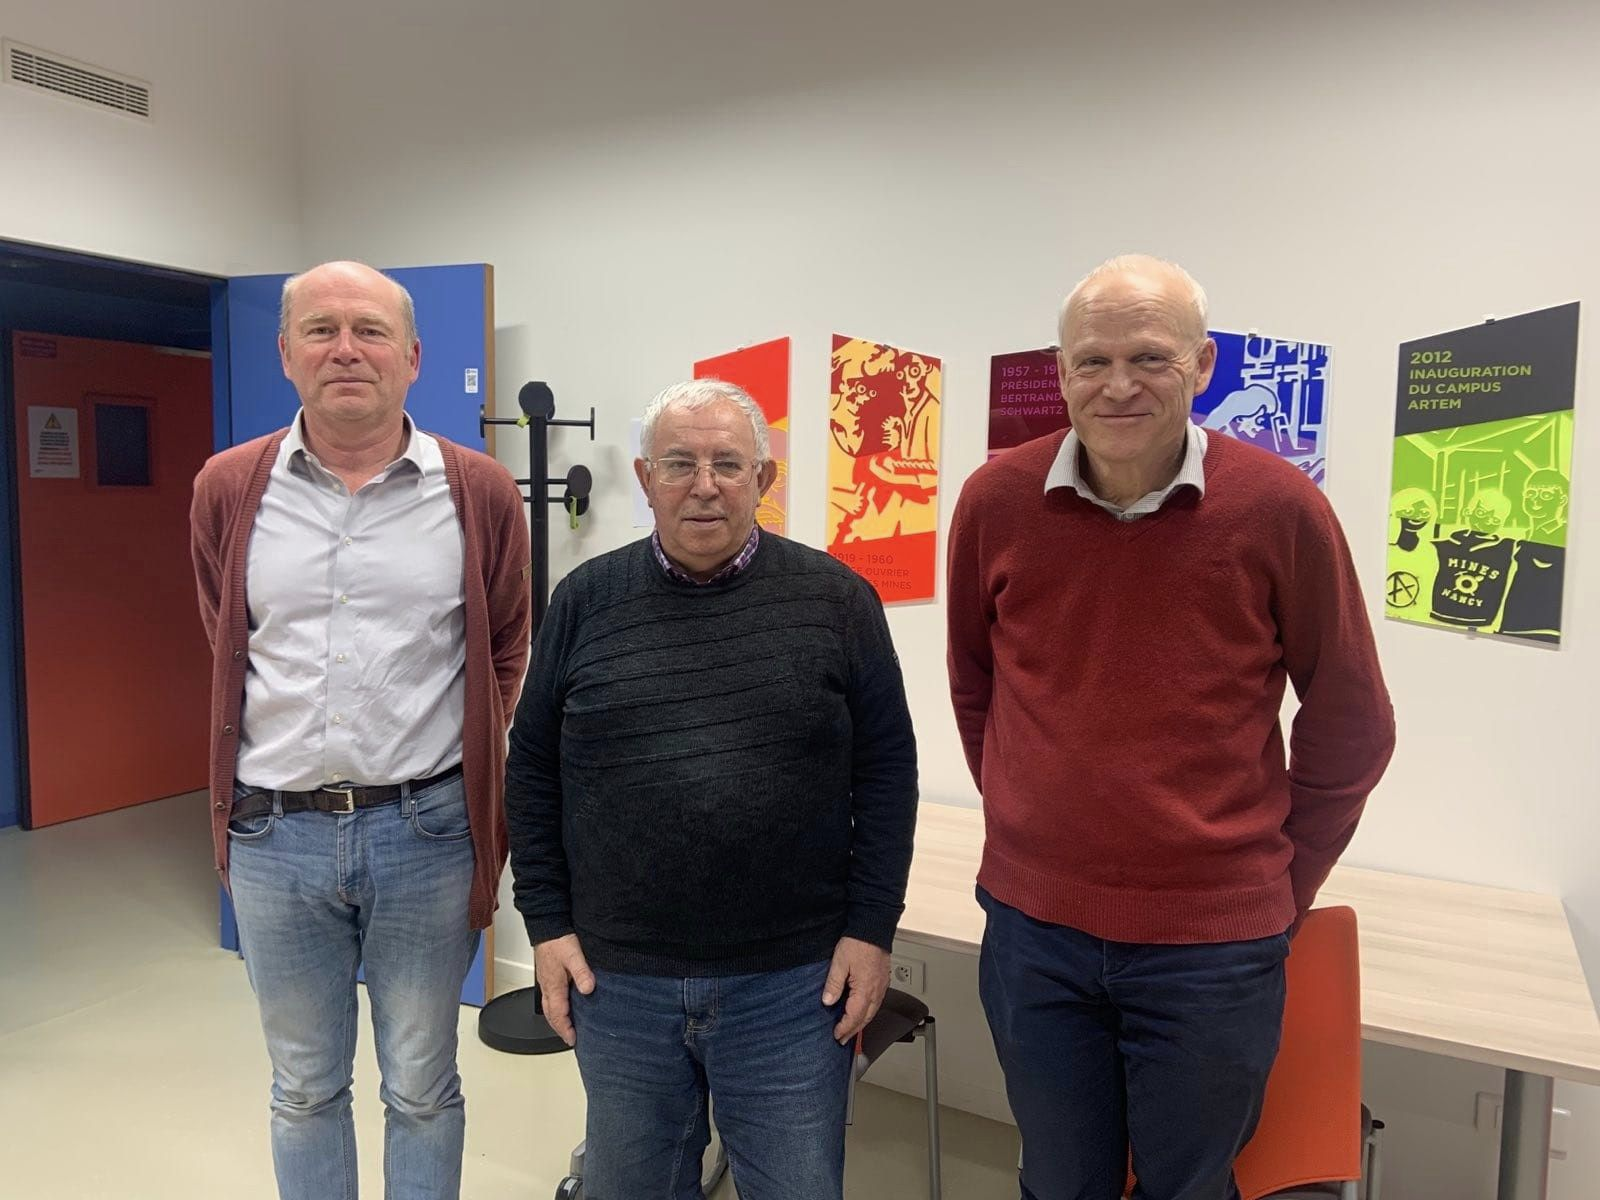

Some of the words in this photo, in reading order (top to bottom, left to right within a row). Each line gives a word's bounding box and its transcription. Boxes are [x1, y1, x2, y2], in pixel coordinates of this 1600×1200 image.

[1410, 351, 1452, 364] 2012
[1001, 366, 1030, 377] 1957
[1044, 365, 1057, 375] 19
[1409, 365, 1532, 380] INAUGURATION
[1408, 384, 1431, 395] DU
[1435, 381, 1502, 394] CAMPUS
[1000, 393, 1063, 403] BERTRAND
[1407, 398, 1462, 410] ARTEM
[1000, 406, 1064, 416] SCHWARTZ
[865, 567, 910, 577] OUVRIER
[881, 581, 912, 590] MINES
[1441, 588, 1483, 607] NANCY
